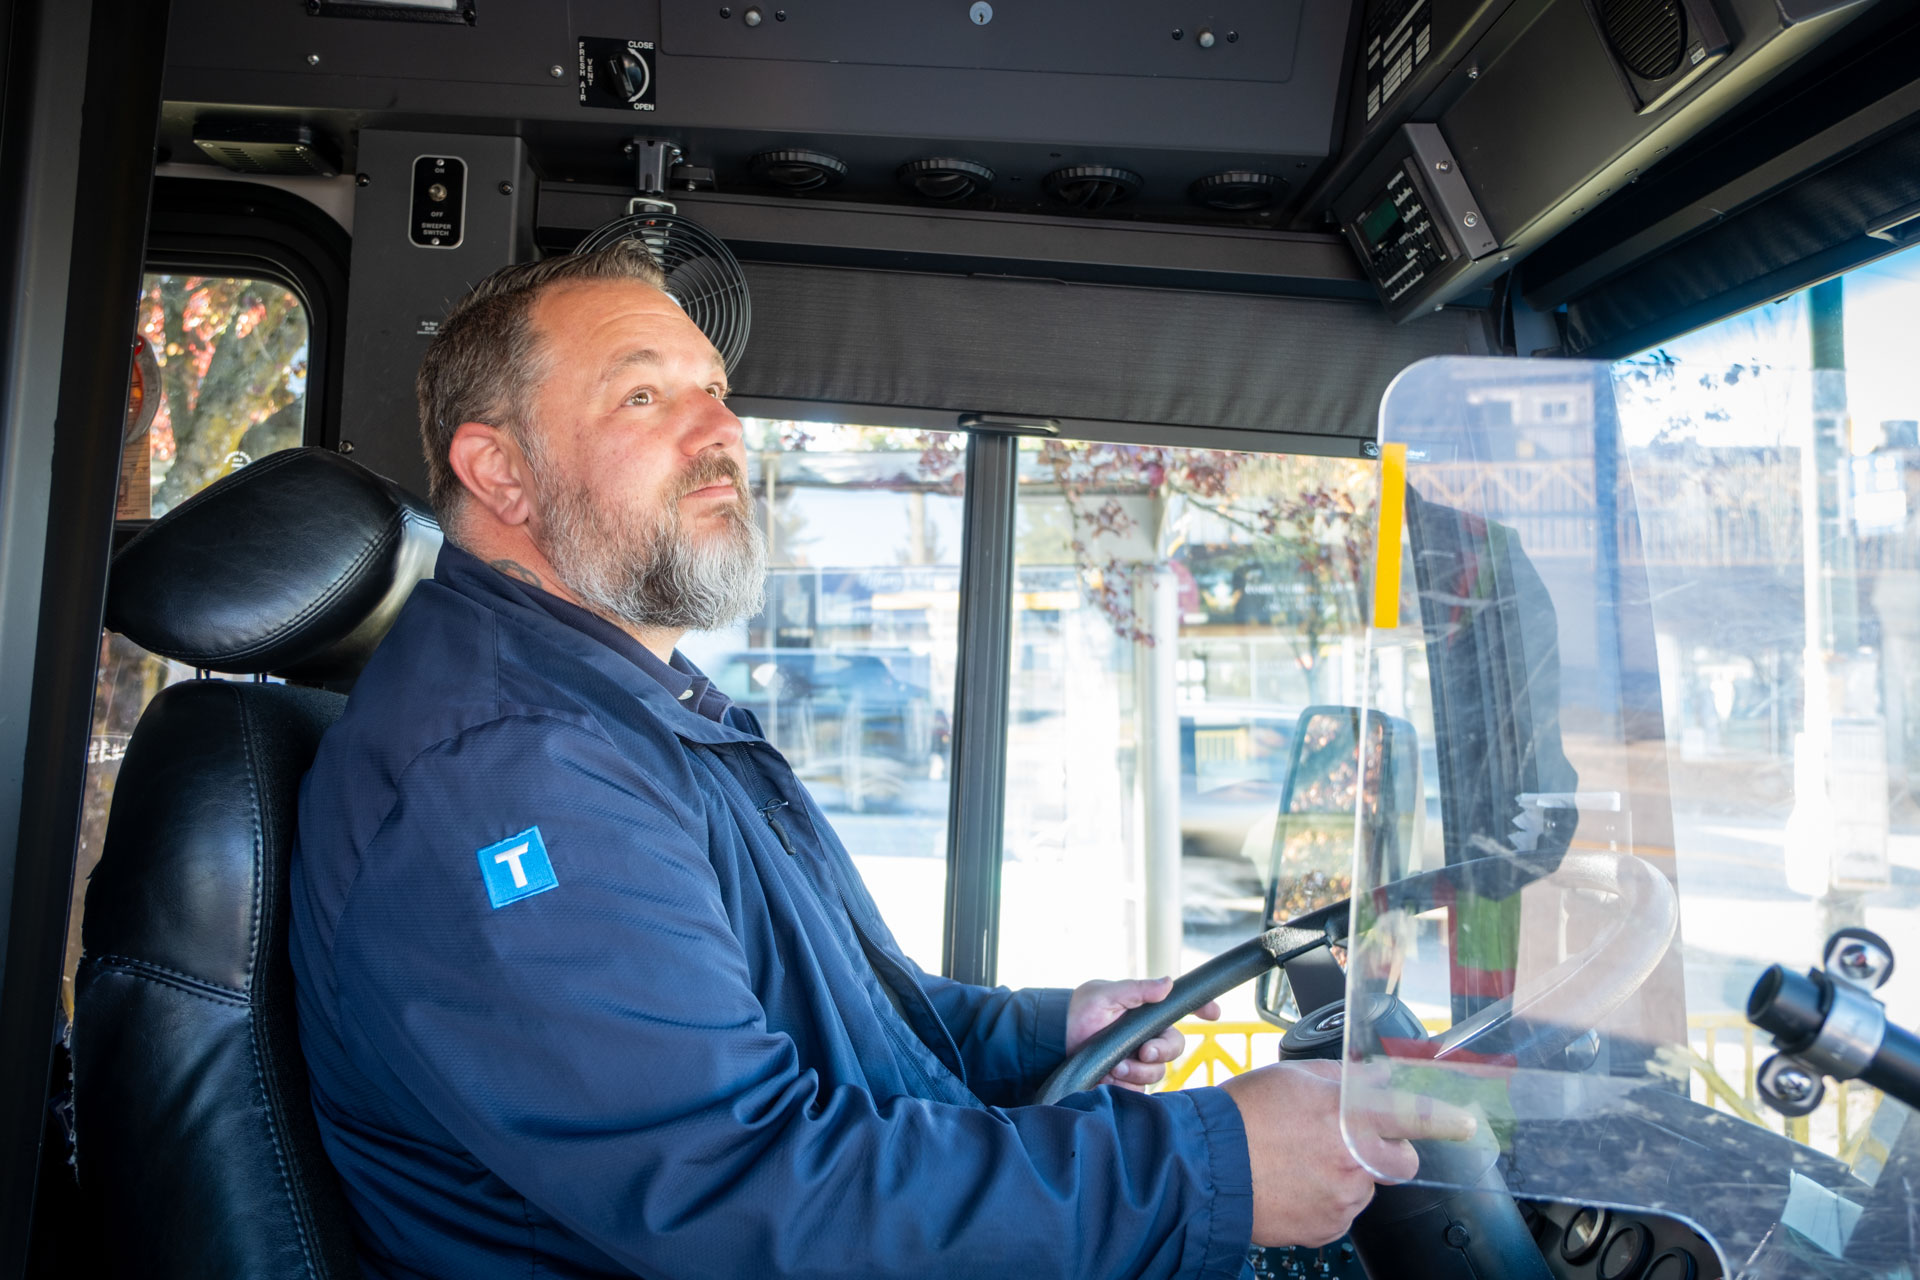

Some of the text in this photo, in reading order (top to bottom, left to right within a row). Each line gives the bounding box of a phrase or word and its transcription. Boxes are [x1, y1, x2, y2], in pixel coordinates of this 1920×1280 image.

[628, 41, 654, 50] CLOSE
[633, 103, 654, 111] OPEN
[421, 222, 452, 230] SWEEPER
[494, 841, 529, 889] T
